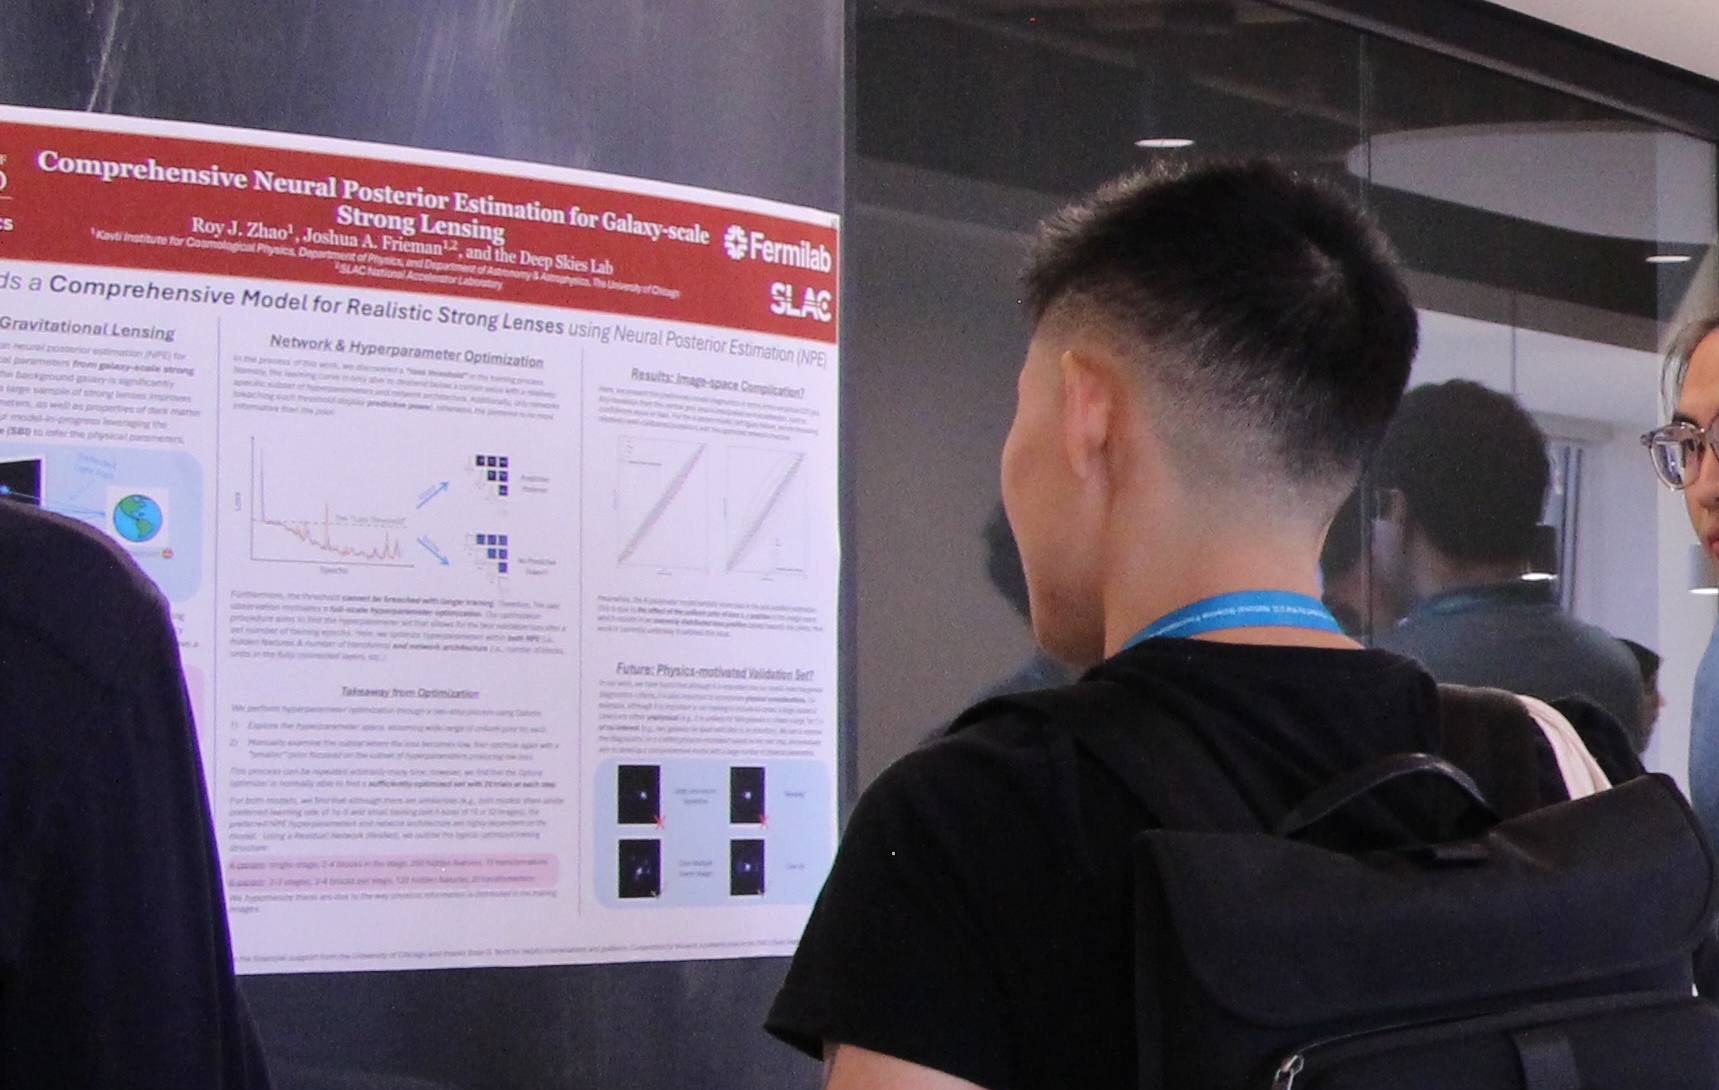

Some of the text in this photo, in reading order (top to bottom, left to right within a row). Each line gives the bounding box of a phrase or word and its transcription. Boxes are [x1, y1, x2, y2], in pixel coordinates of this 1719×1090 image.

[37, 150, 710, 245] Comprehensive Neural Posterior Estimation for Galaxy-scale
[337, 205, 505, 245] Strong Lensing
[123, 232, 167, 246] Institute
[169, 234, 185, 246] for
[299, 247, 356, 263] Department
[358, 251, 367, 261] of
[192, 217, 225, 238] Roy
[227, 222, 243, 237] J.
[303, 227, 358, 247] Joshua
[362, 236, 377, 249] A.
[466, 245, 491, 261] and
[495, 246, 516, 263] the
[520, 253, 553, 270] Deep
[555, 255, 588, 272] Skies
[591, 260, 614, 275] Lab
[751, 231, 832, 273] Fermilab
[770, 282, 832, 322] SLAC
[0, 315, 176, 342] Gravitational Lensing
[28, 277, 42, 291] a
[50, 274, 235, 305] Comprehensive
[241, 289, 307, 312] Model
[313, 294, 342, 314] for
[347, 298, 432, 322] Realistic
[438, 305, 498, 331] Strong
[503, 312, 564, 336] Lenses
[568, 322, 611, 345] using
[613, 325, 663, 346] Neural
[666, 331, 727, 354] Posterior
[729, 338, 794, 362] Estimation
[797, 348, 827, 369] (NPE)
[270, 334, 331, 351] Network
[335, 339, 345, 352] &
[350, 339, 463, 363] Hyperparameter
[464, 349, 544, 369] Optimization
[631, 368, 674, 386] Results:
[616, 662, 654, 676] Future:
[656, 663, 746, 679] Physics-motivated
[749, 668, 793, 681] Validation
[342, 686, 480, 699] Takeaway from Optimization
